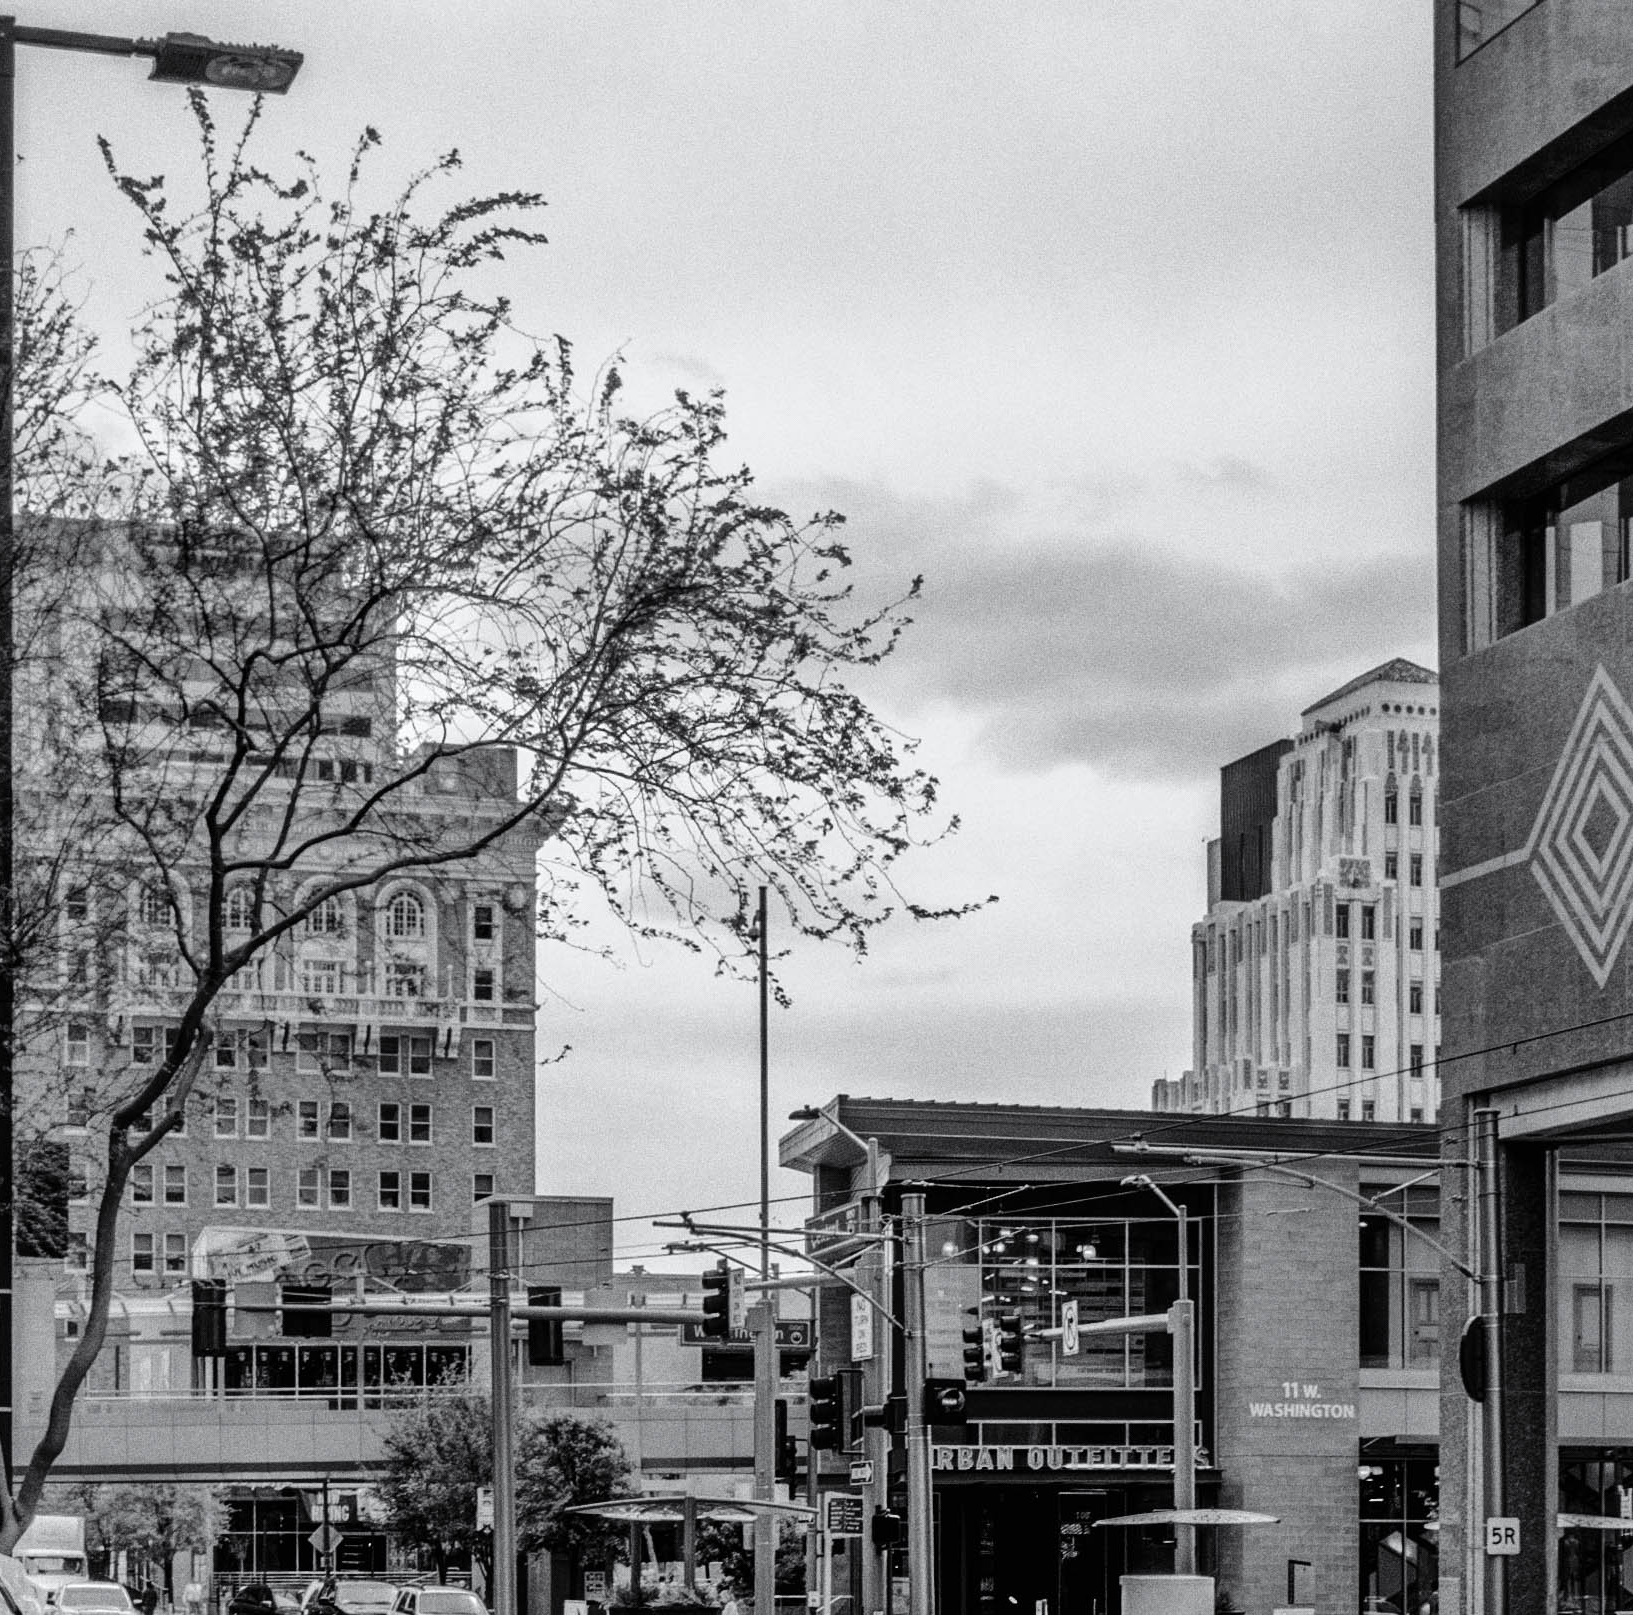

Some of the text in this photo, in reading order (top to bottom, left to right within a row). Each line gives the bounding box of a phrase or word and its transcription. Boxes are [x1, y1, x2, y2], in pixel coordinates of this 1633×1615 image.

[1281, 1381, 1298, 1398] 11
[1249, 1403, 1355, 1418] WASHINGTON
[933, 1446, 1211, 1470] RBAN OUTFITTES
[311, 1505, 349, 1521] HIING
[1492, 1527, 1515, 1545] 5R
